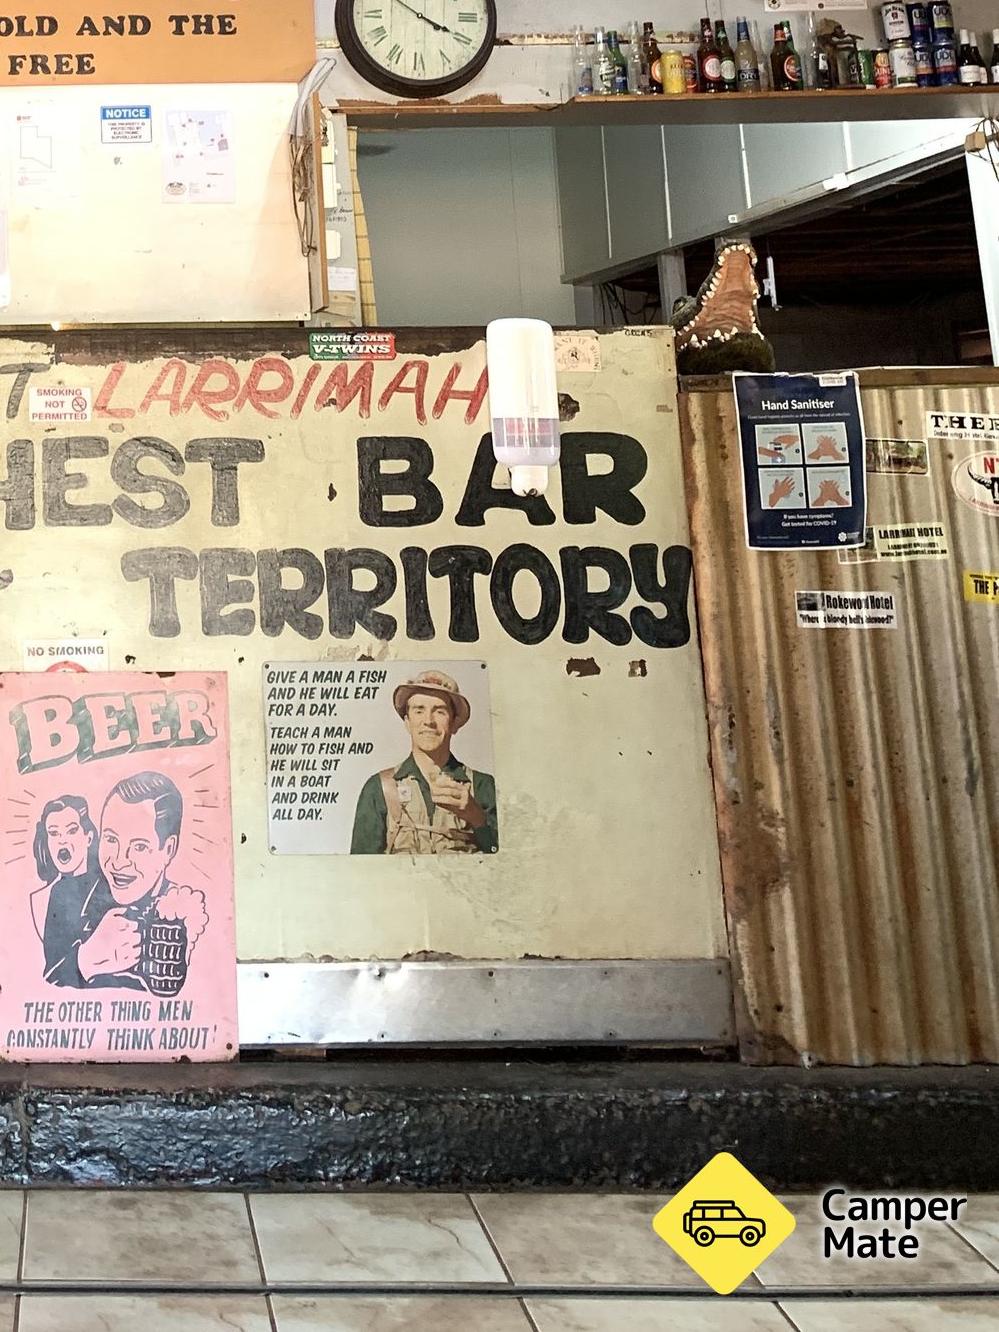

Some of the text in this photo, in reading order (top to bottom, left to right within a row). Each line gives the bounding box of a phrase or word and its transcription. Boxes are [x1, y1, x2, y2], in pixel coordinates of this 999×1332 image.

[76, 13, 153, 38] AND
[170, 12, 238, 37] THE
[8, 52, 97, 77] FREE
[105, 108, 146, 118] NOTICE
[312, 334, 392, 342] NORTH COAST
[312, 344, 391, 354] V-TWINS
[36, 388, 82, 396] SMOKING
[92, 358, 489, 427] LARRIMAH
[761, 398, 835, 410] Hand Sanitiser
[32, 412, 87, 420] PERMITTED
[984, 457, 999, 474] N
[356, 432, 647, 528] BAR
[974, 579, 989, 595] THE
[120, 542, 694, 648] TERRITORY
[869, 595, 894, 610] Hotel
[27, 646, 104, 656] NO SMOKING
[267, 671, 387, 684] GIVE A MAN A FISH
[267, 687, 379, 700] AND HE WILL EAT
[268, 704, 337, 716] FOR A DAY.
[9, 690, 217, 775] BEER
[271, 727, 352, 739] TEACH A MAN
[270, 743, 373, 755] HOW TO FISH AND
[270, 759, 340, 771] HE WILL SIT
[271, 776, 331, 787] IN A BOAT
[272, 792, 339, 804] AND DRINK
[272, 808, 323, 820] ALL DAY.
[24, 1001, 55, 1023] THE
[58, 1001, 102, 1022] OTHER
[158, 1000, 193, 1021] MEN
[7, 1028, 96, 1049] CONSTANTLY
